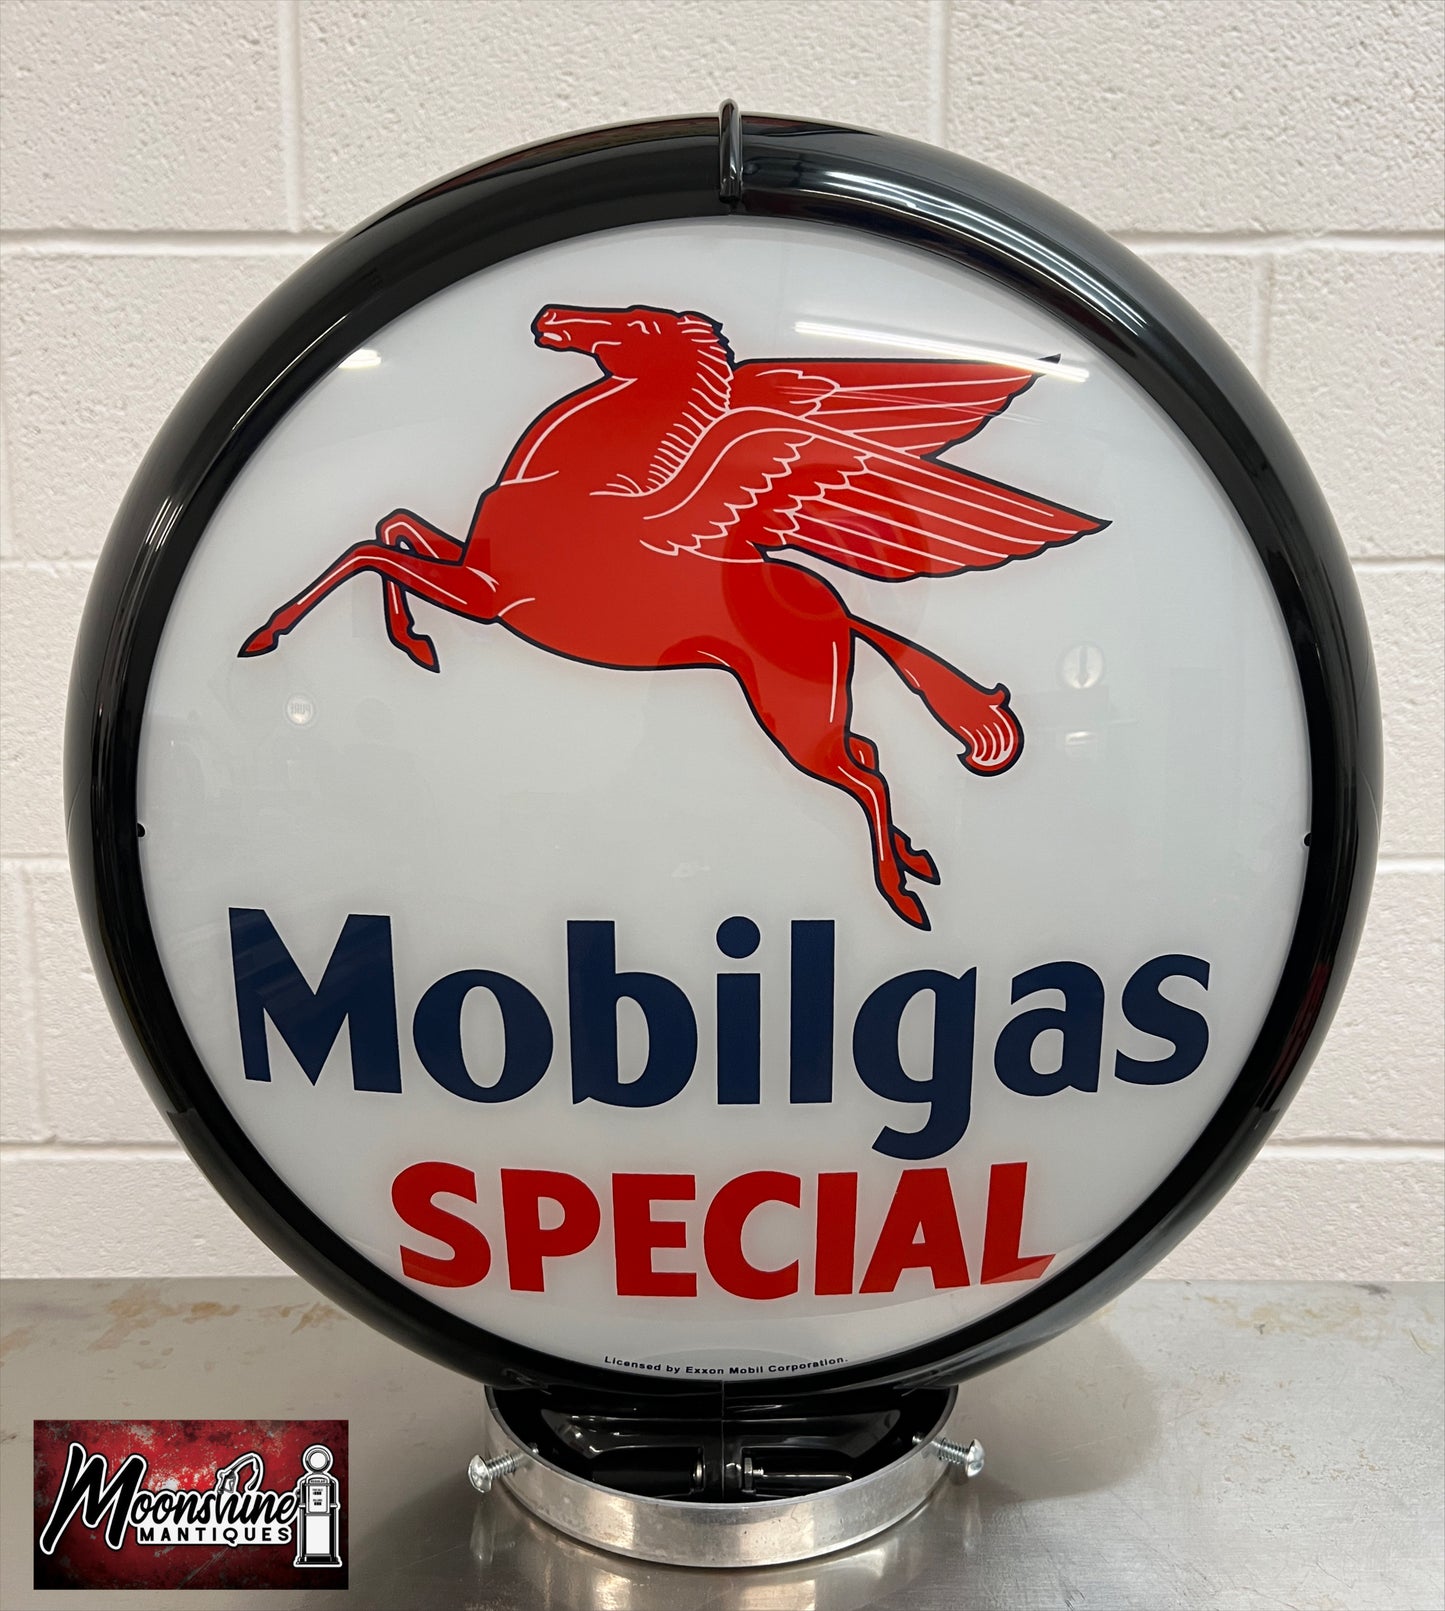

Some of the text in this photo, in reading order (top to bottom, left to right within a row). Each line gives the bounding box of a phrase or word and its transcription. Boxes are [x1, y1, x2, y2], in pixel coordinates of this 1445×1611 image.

[229, 907, 1210, 1160] Mobilgas
[391, 1162, 1054, 1300] SPECIAL
[604, 1356, 849, 1375] Licensed by Exxon Mobil Corporation.
